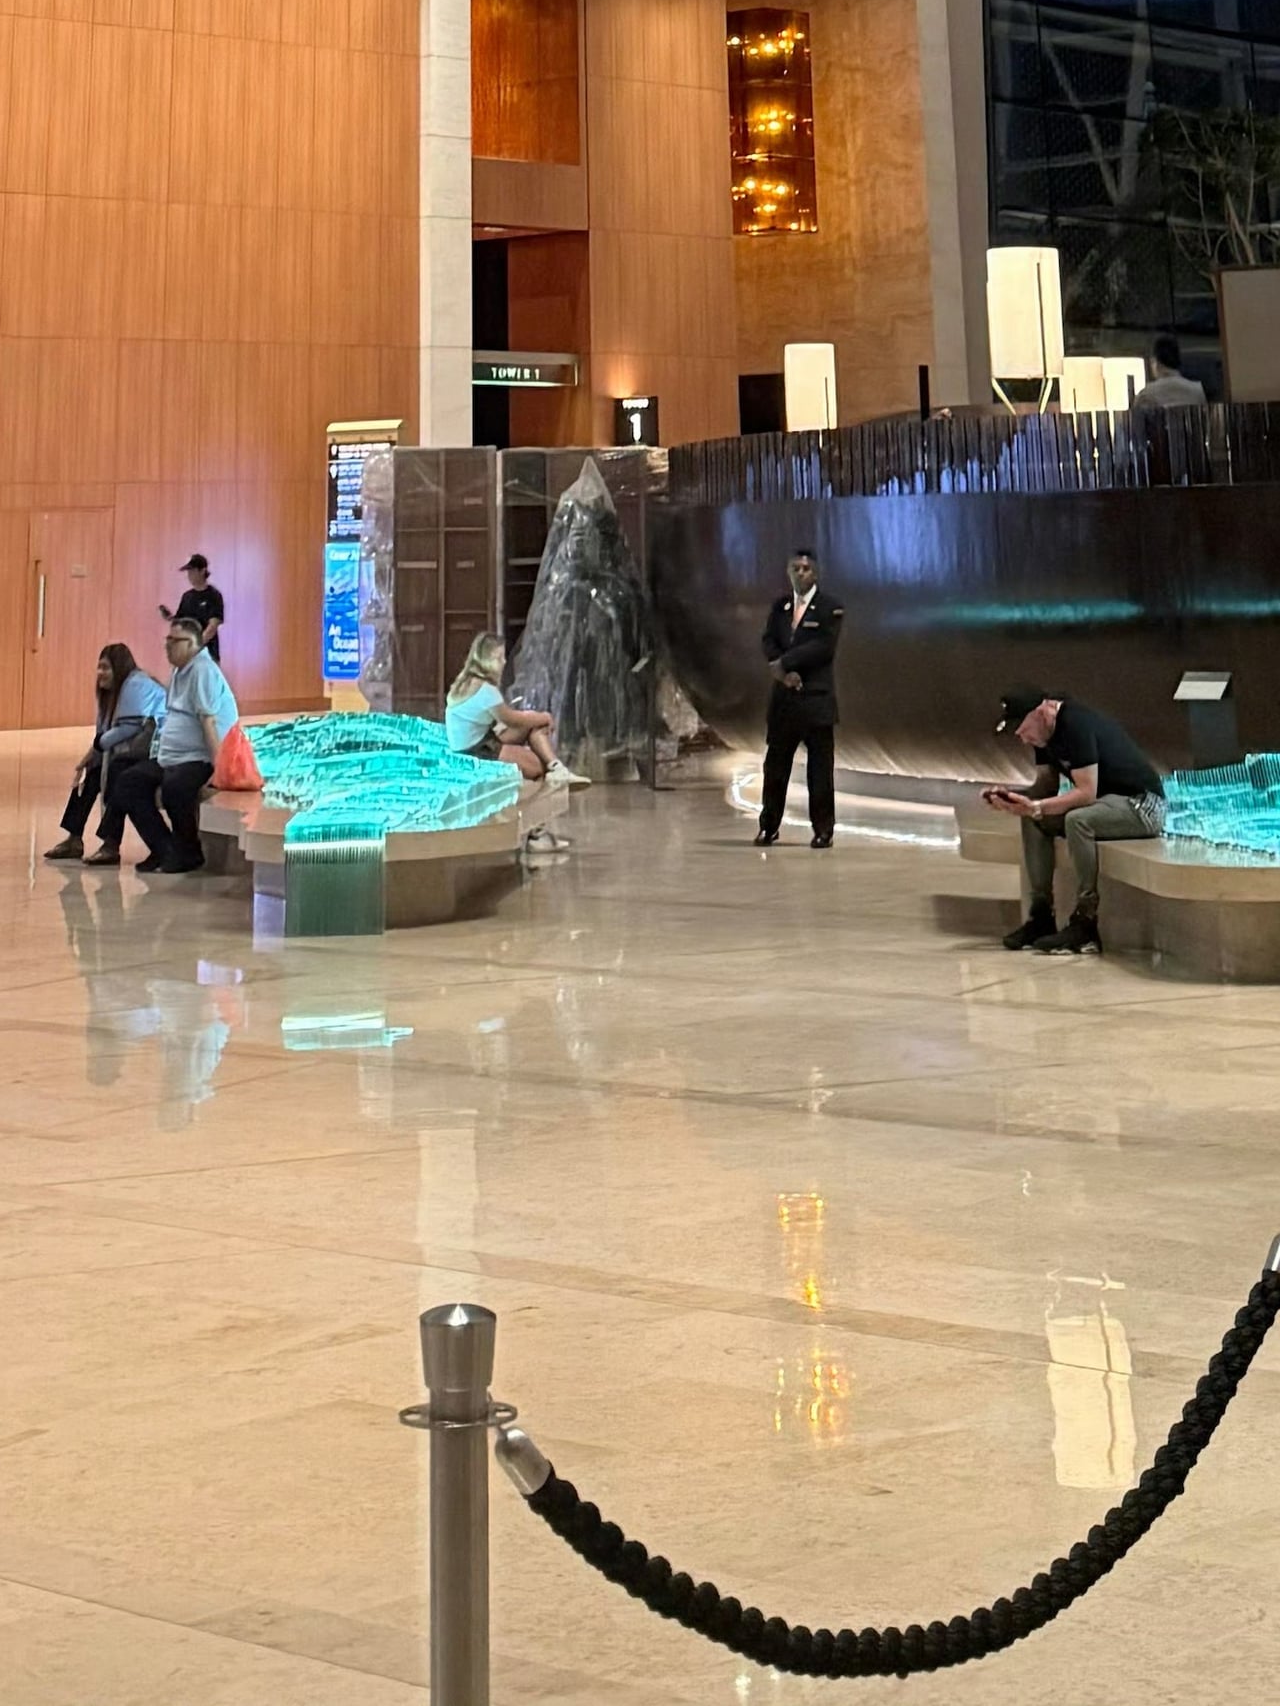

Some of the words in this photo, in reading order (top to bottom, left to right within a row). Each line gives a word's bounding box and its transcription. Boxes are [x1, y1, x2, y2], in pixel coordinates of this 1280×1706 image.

[490, 366, 531, 380] TOWER
[534, 368, 540, 381] 1
[629, 412, 642, 442] 1
